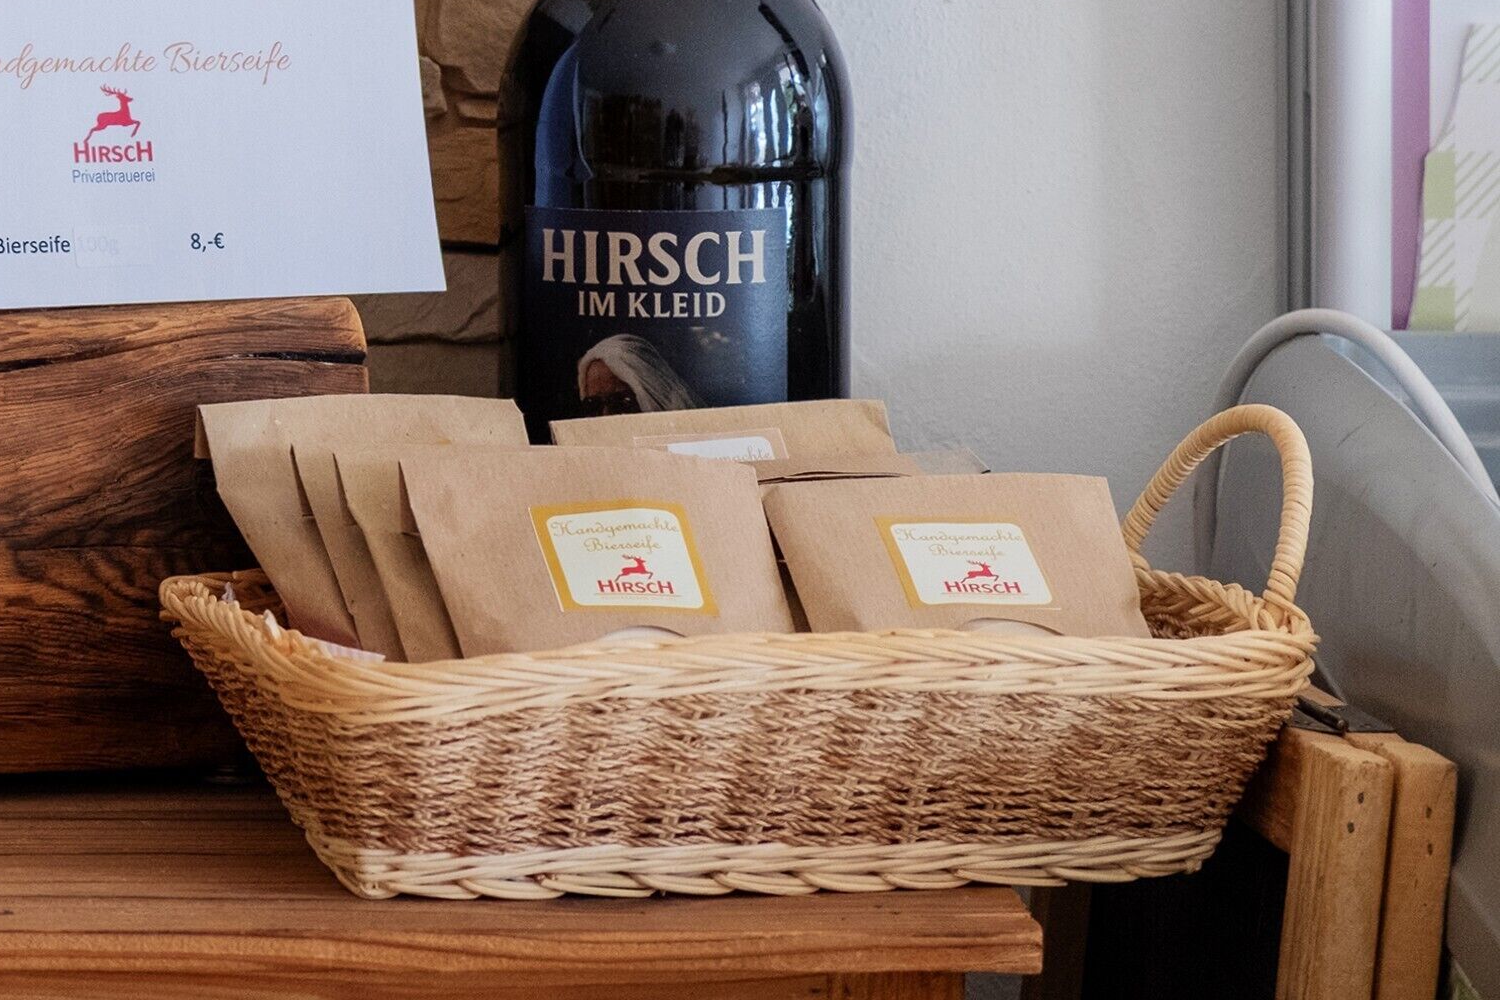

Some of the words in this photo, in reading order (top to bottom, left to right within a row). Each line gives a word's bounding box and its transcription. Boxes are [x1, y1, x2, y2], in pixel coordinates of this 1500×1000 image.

[163, 41, 293, 86] Bierseife
[73, 140, 154, 164] HIRSCH
[71, 168, 156, 185] Privatbrauerei
[190, 232, 225, 253] 8,-€
[542, 228, 767, 287] HIRSCH
[577, 290, 617, 318] IM
[627, 292, 727, 319] KLEID
[550, 516, 680, 538] Handgemachte
[597, 579, 675, 595] HIRSCH
[944, 580, 1022, 594] HIRSCH
